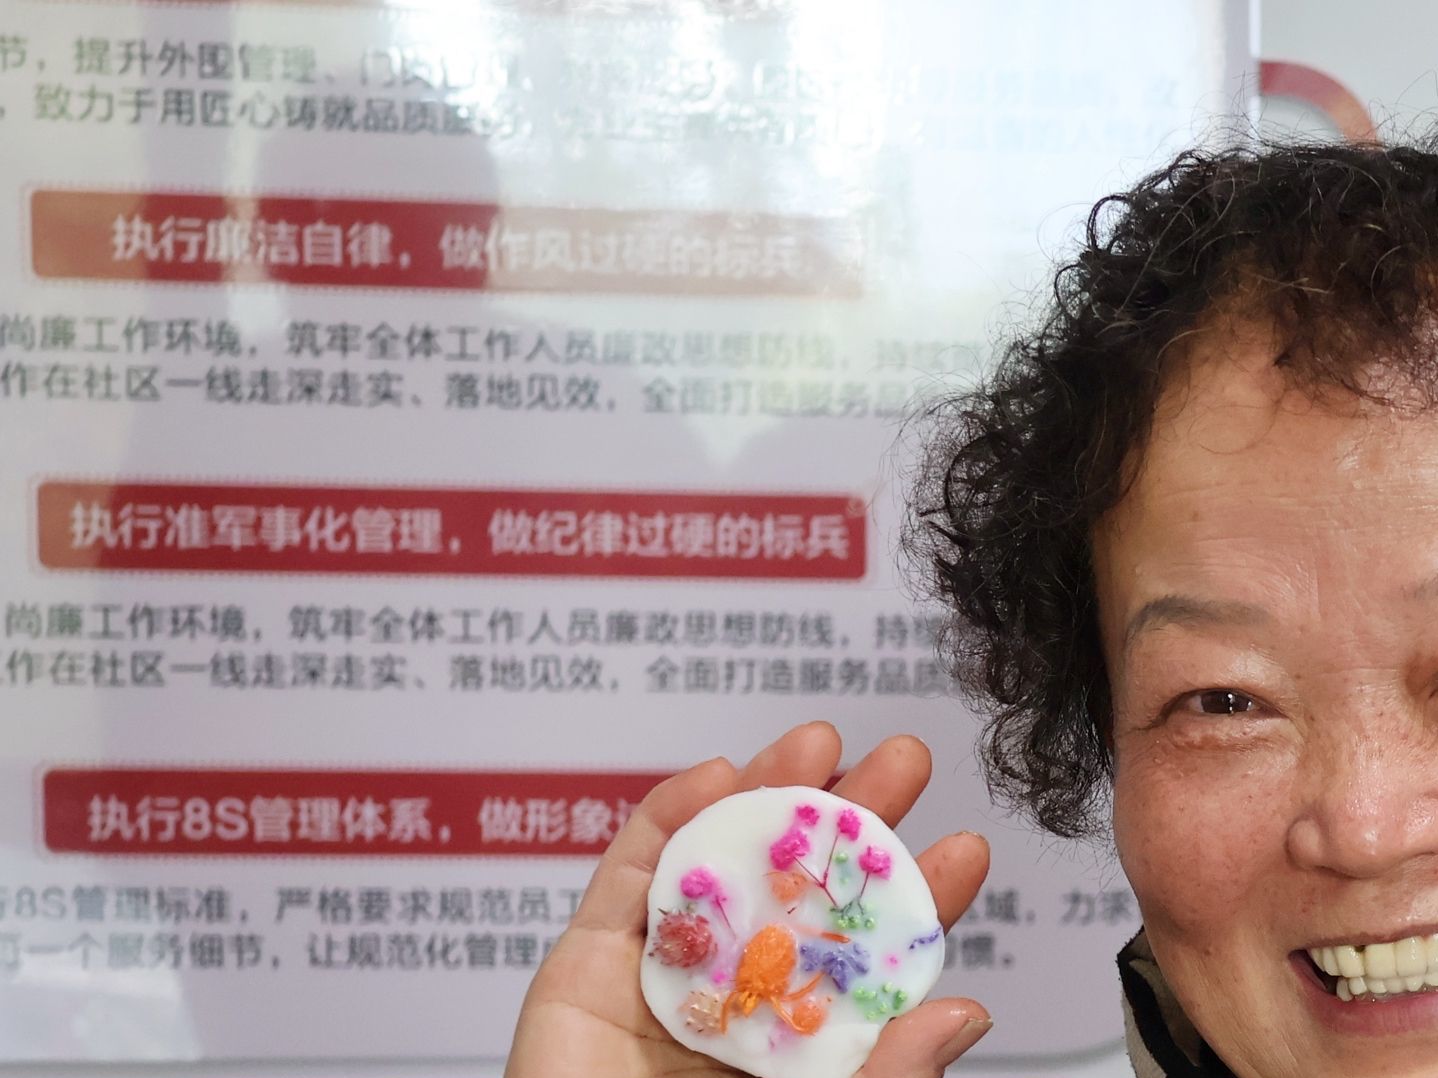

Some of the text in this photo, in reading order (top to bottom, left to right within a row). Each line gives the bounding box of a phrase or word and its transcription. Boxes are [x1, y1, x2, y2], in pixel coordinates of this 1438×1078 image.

[71, 502, 850, 561] 执行准军事化管理，做纪律过硬的标兵
[0, 885, 583, 924] 8S管理标准，严格要求规范员工
